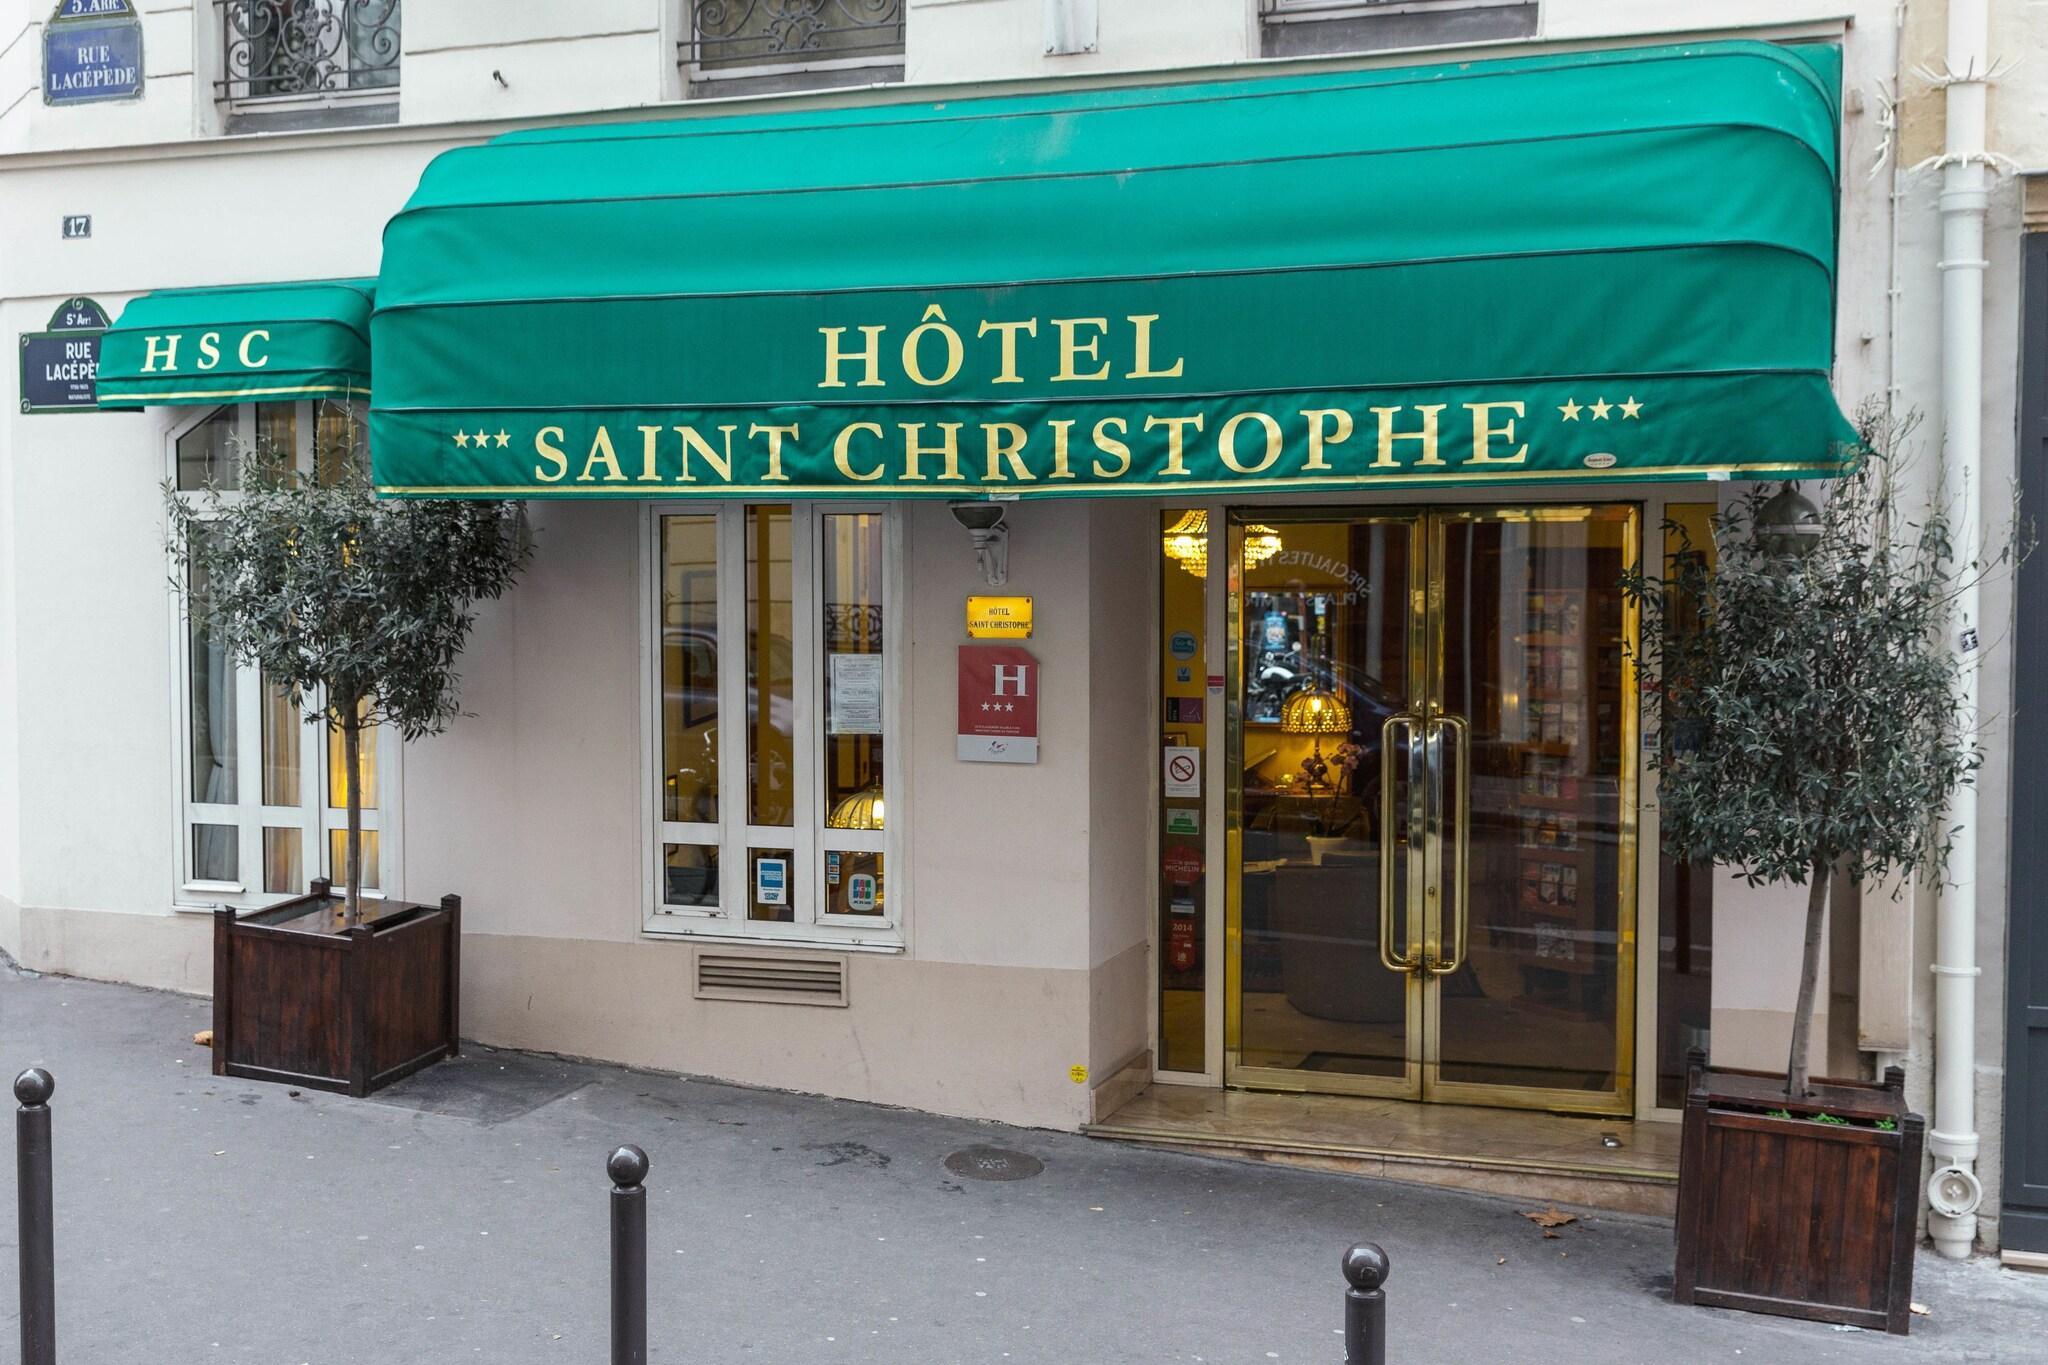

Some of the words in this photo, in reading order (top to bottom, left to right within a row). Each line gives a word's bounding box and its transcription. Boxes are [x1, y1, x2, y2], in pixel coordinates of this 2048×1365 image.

[78, 45, 110, 65] RUE
[51, 65, 136, 91] LACÉPÈDE
[69, 217, 87, 236] 17
[66, 341, 92, 359] RUE
[817, 303, 1184, 389] HÔTEL
[534, 421, 800, 483] SAINT
[833, 400, 1529, 482] CHRISTOPHE
[969, 621, 989, 630] SAINT
[990, 621, 1030, 629] CHRISTOPHE
[992, 664, 1030, 697] H
[1165, 864, 1200, 873] MICHELIN
